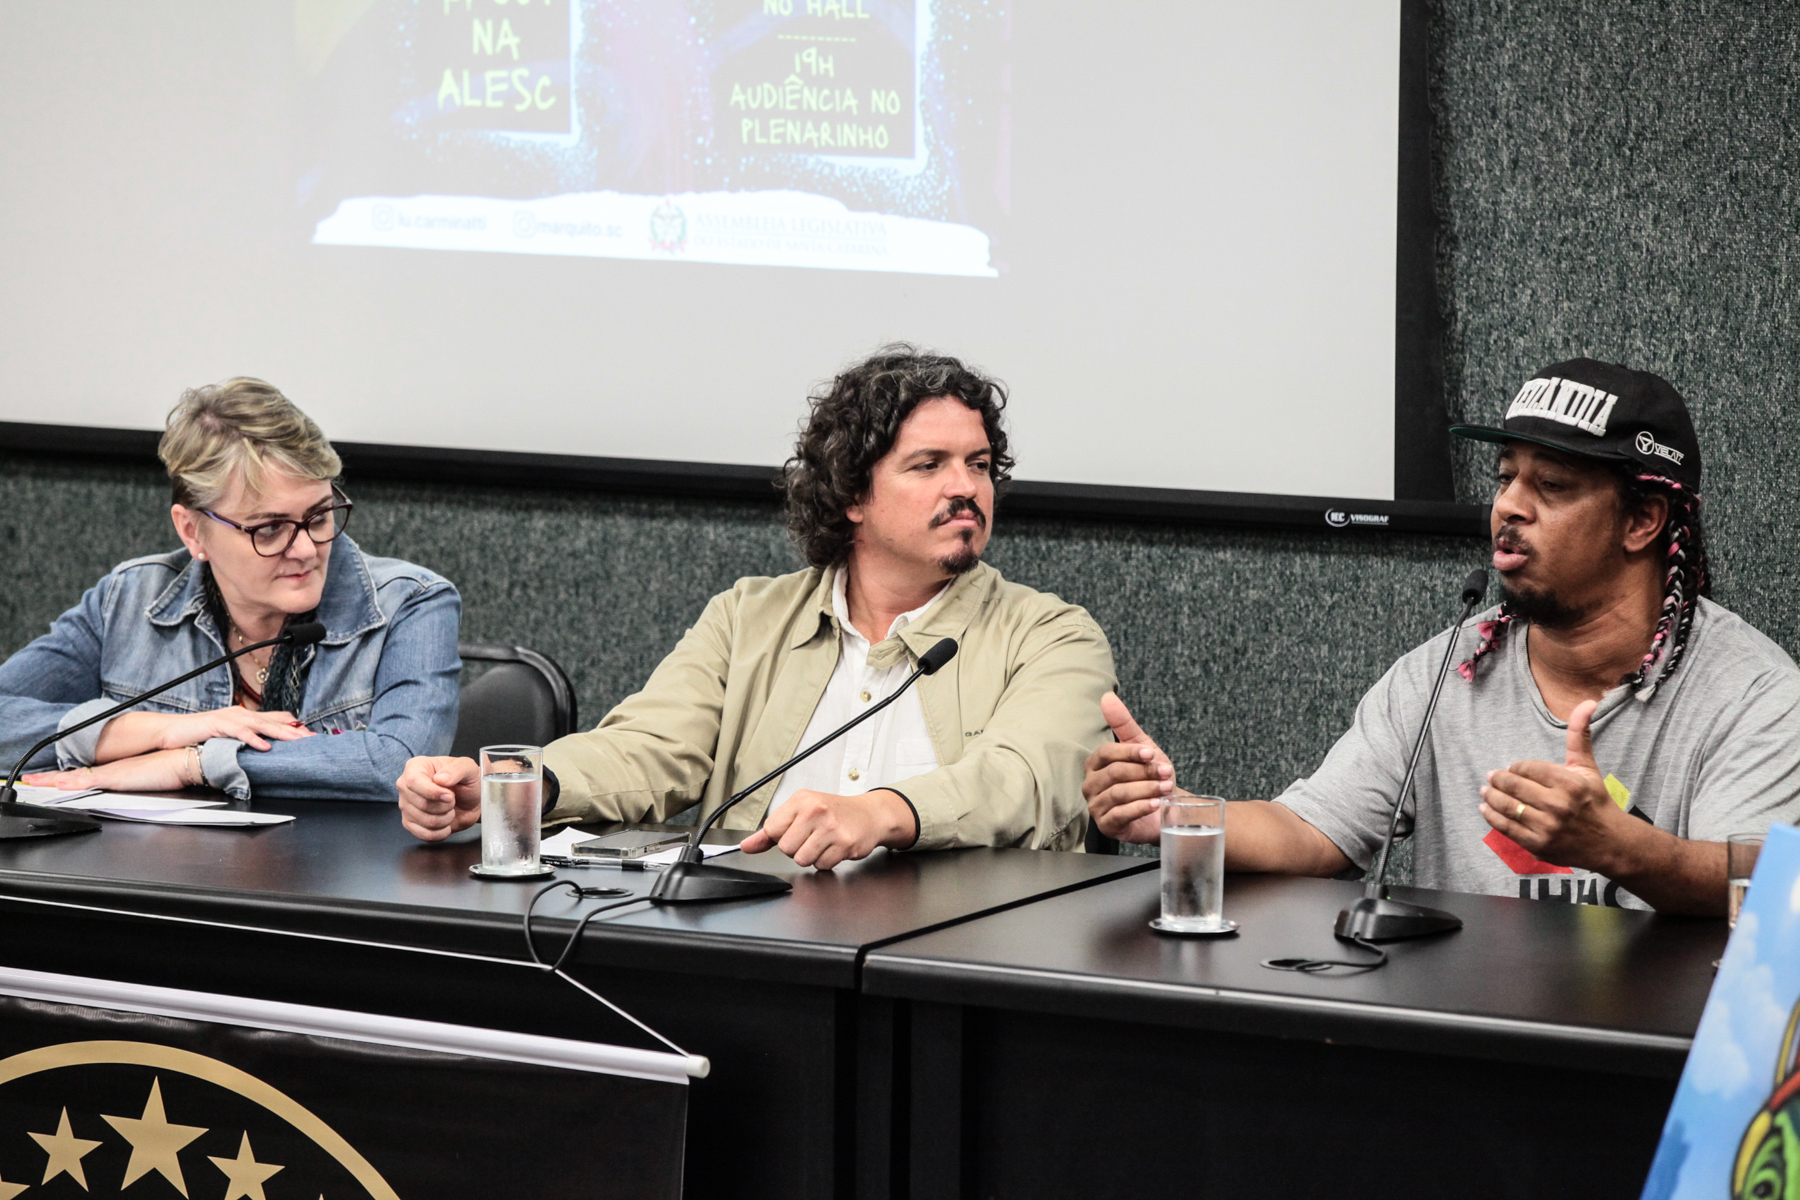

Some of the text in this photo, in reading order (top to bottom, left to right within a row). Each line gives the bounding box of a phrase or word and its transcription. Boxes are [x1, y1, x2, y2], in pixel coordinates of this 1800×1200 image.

[763, 0, 871, 20] NO HALL
[472, 18, 521, 60] NA
[794, 47, 835, 77] 19H
[437, 67, 557, 112] ALESC
[729, 73, 901, 115] AUDIÊNCIA NO
[741, 118, 889, 149] PLENARINHO
[694, 213, 888, 237] ASSEMBLEIA LEGISLATIVA
